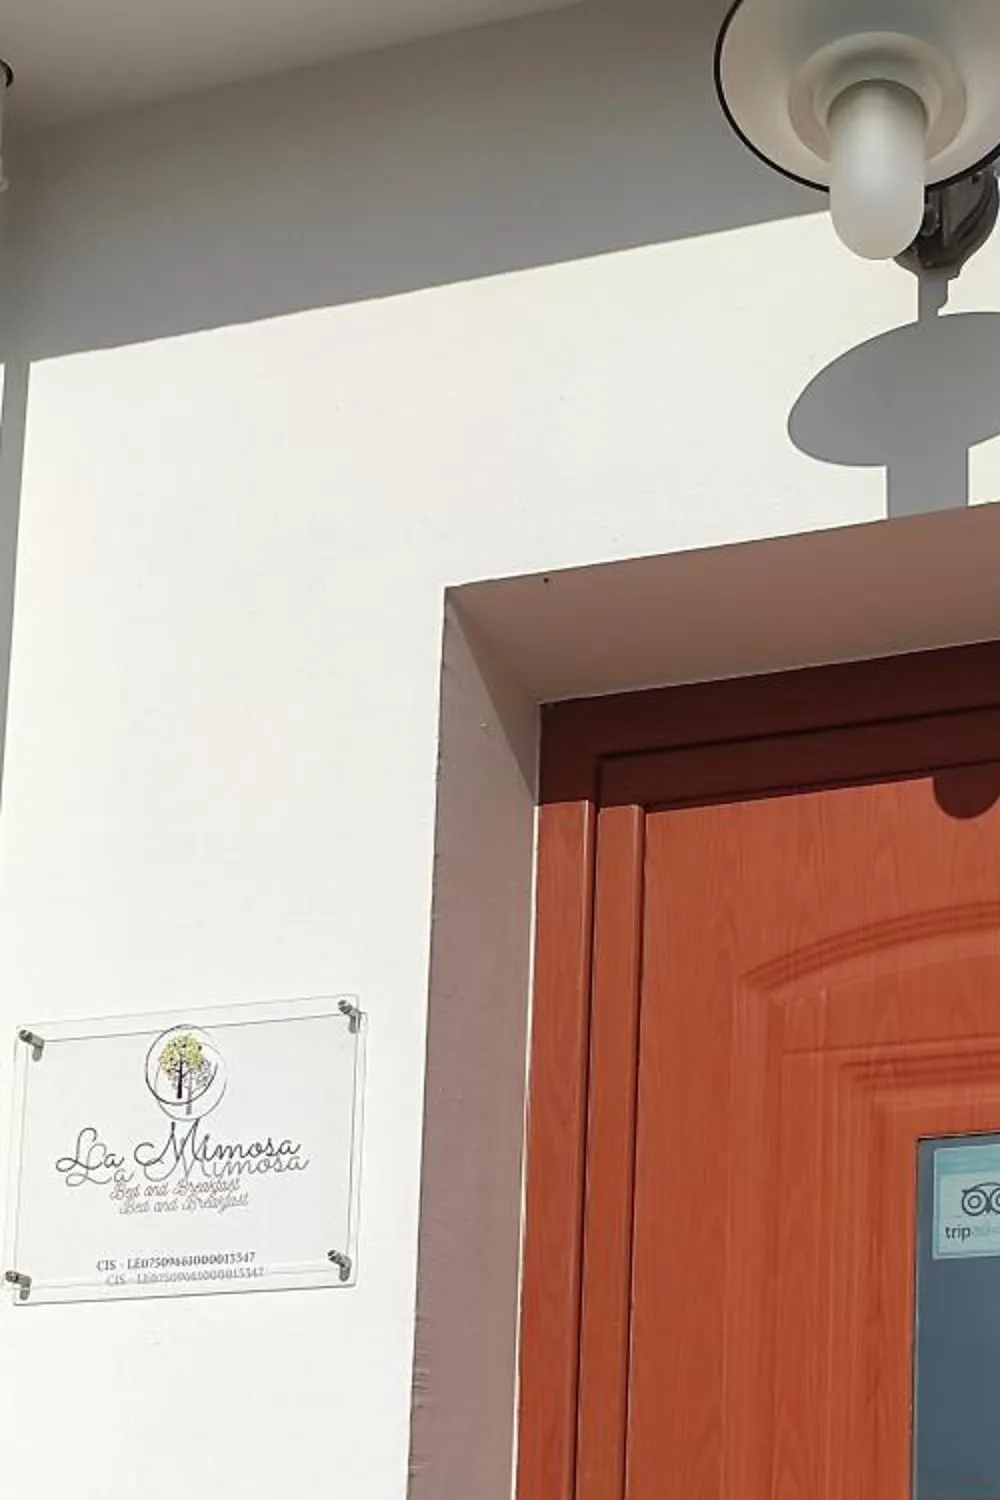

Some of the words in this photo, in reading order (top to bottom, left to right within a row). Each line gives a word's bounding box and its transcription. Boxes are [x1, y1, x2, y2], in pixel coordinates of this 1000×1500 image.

[56, 1127, 125, 1172] La
[133, 1119, 301, 1168] Mimosa
[95, 1259, 117, 1272] CIS
